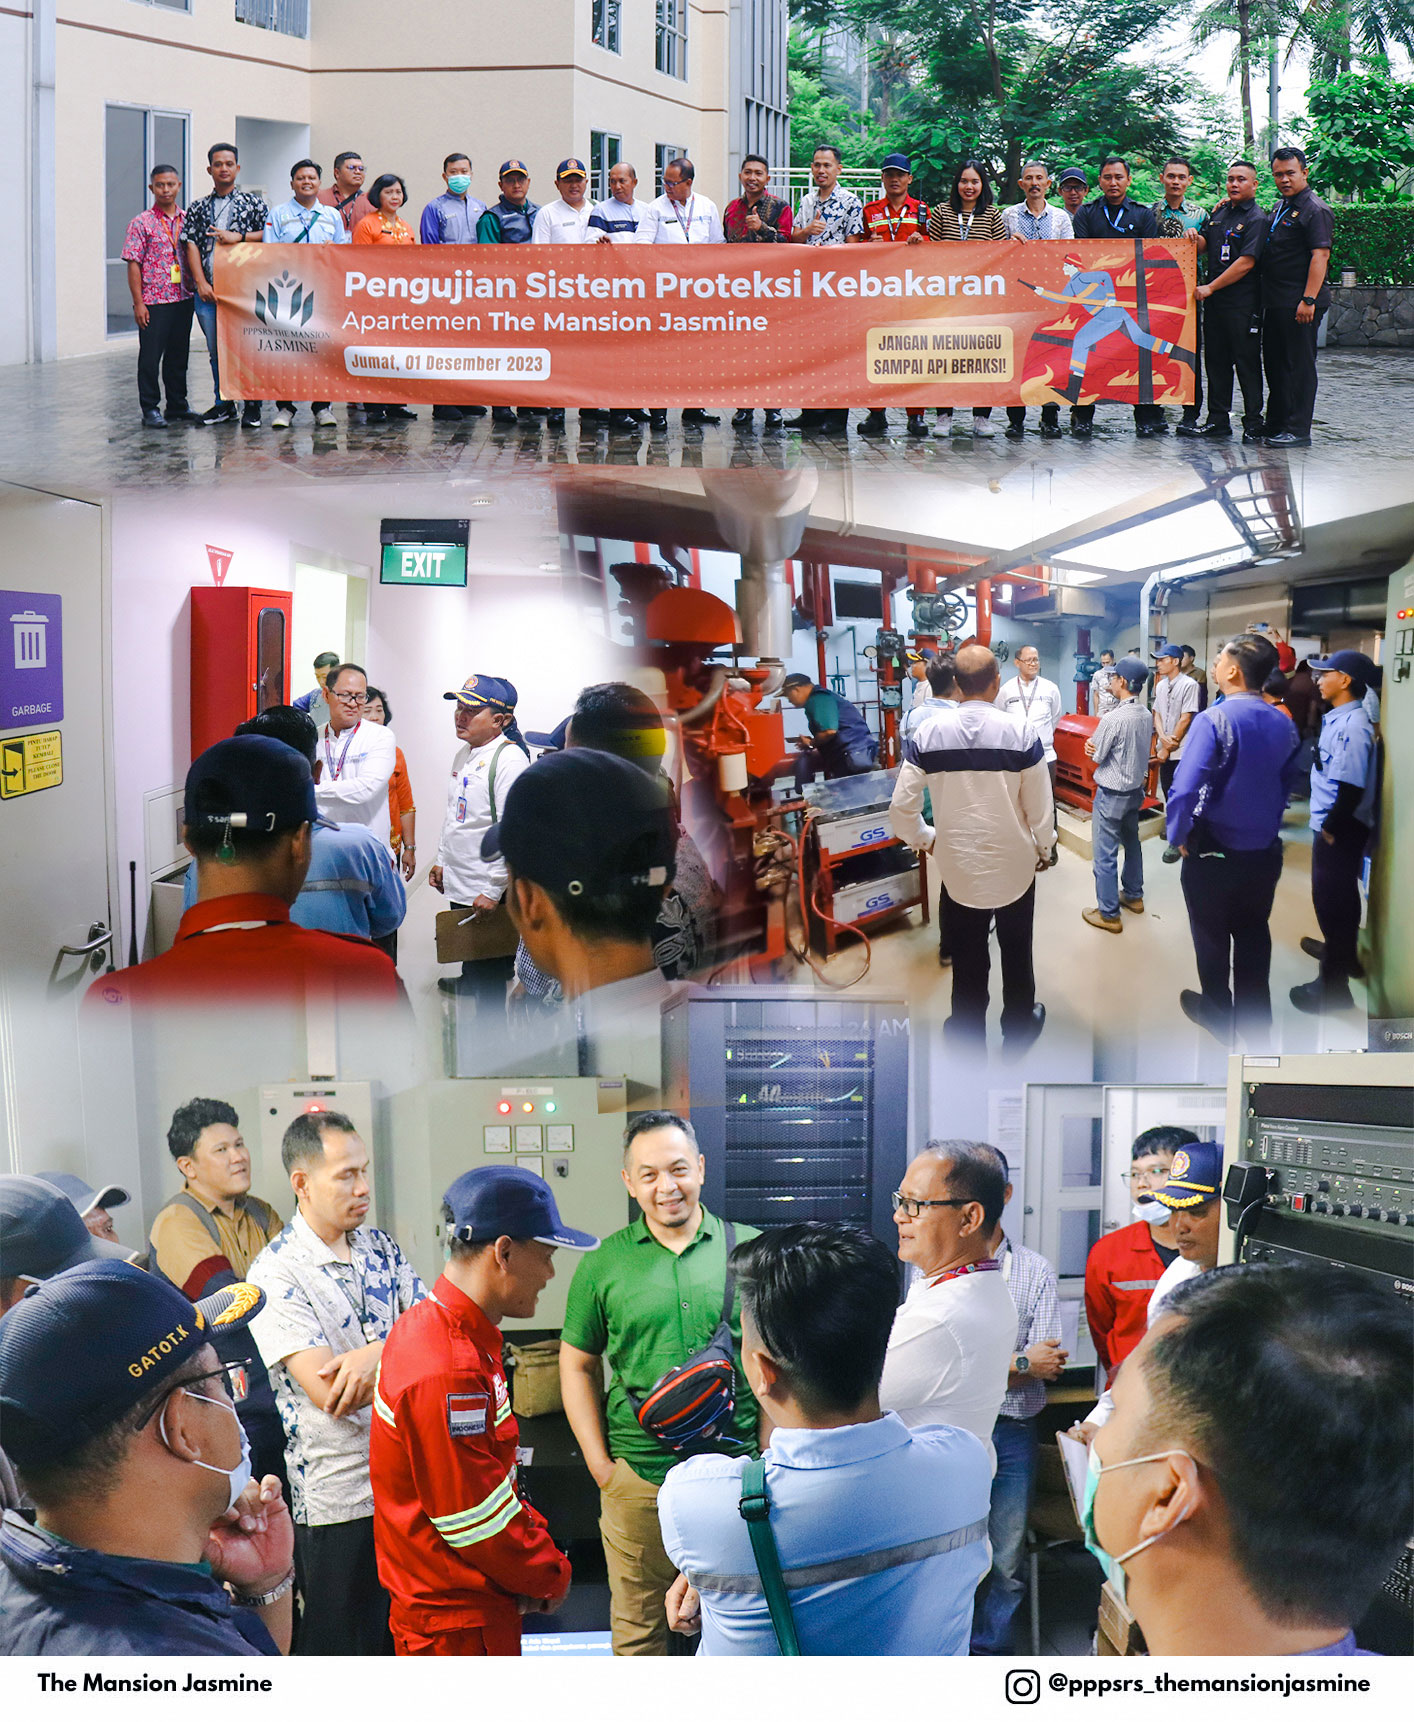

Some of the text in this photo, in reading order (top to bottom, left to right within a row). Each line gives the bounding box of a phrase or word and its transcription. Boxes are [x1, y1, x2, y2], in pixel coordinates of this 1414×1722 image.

[344, 268, 1006, 305] Pengujian Sistem Proteksi Kebakaran
[342, 310, 769, 334] Apartemen The Mansion Jasmine
[243, 327, 330, 339] PPPSRS THE MANSION
[878, 333, 1002, 351] JANGAN MENUNGGU
[257, 338, 318, 354] JASMINE
[351, 353, 543, 372] Jumat, 01 Desember 2023
[873, 357, 1007, 375] SAMPAI API BERAKSI!
[401, 551, 446, 578] EXIT
[11, 702, 53, 717] GARBAGE
[860, 826, 886, 842] GS
[865, 892, 891, 908] GS
[128, 1323, 190, 1378] GATOT.K
[451, 1424, 484, 1432] INDONESIA
